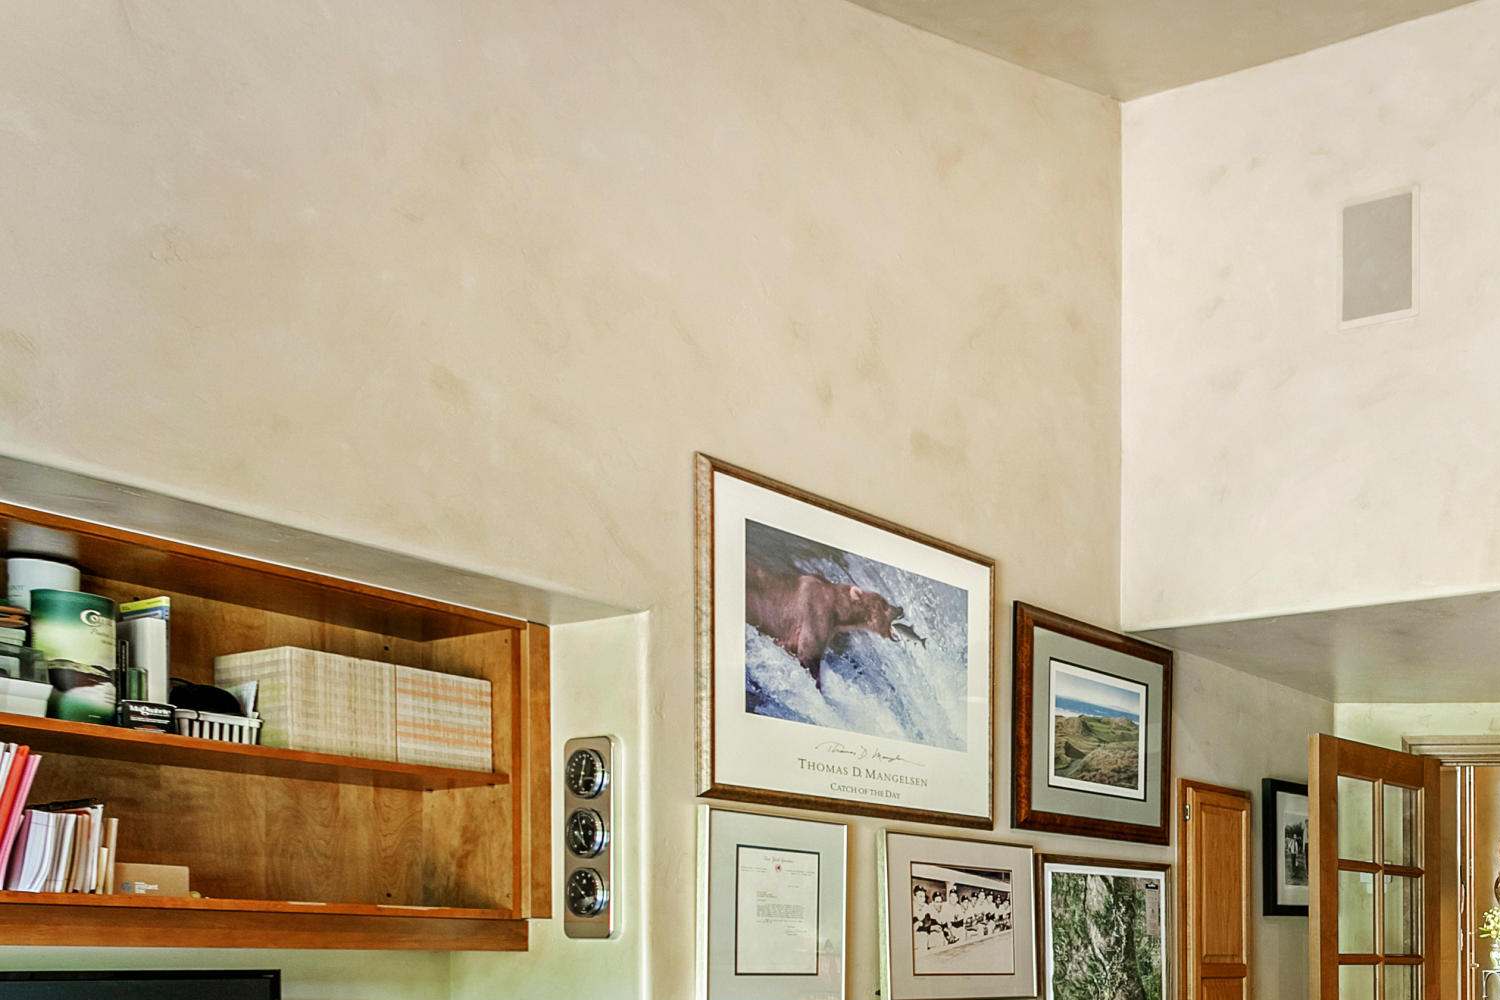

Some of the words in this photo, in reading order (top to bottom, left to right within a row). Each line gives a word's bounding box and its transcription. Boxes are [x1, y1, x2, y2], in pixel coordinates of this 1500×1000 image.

[798, 757, 849, 776] THOMAS
[865, 768, 928, 788] MANGELSEN
[830, 782, 857, 794] CATCH
[858, 786, 868, 795] OF
[870, 788, 885, 798] THE
[885, 789, 901, 800] DAY
